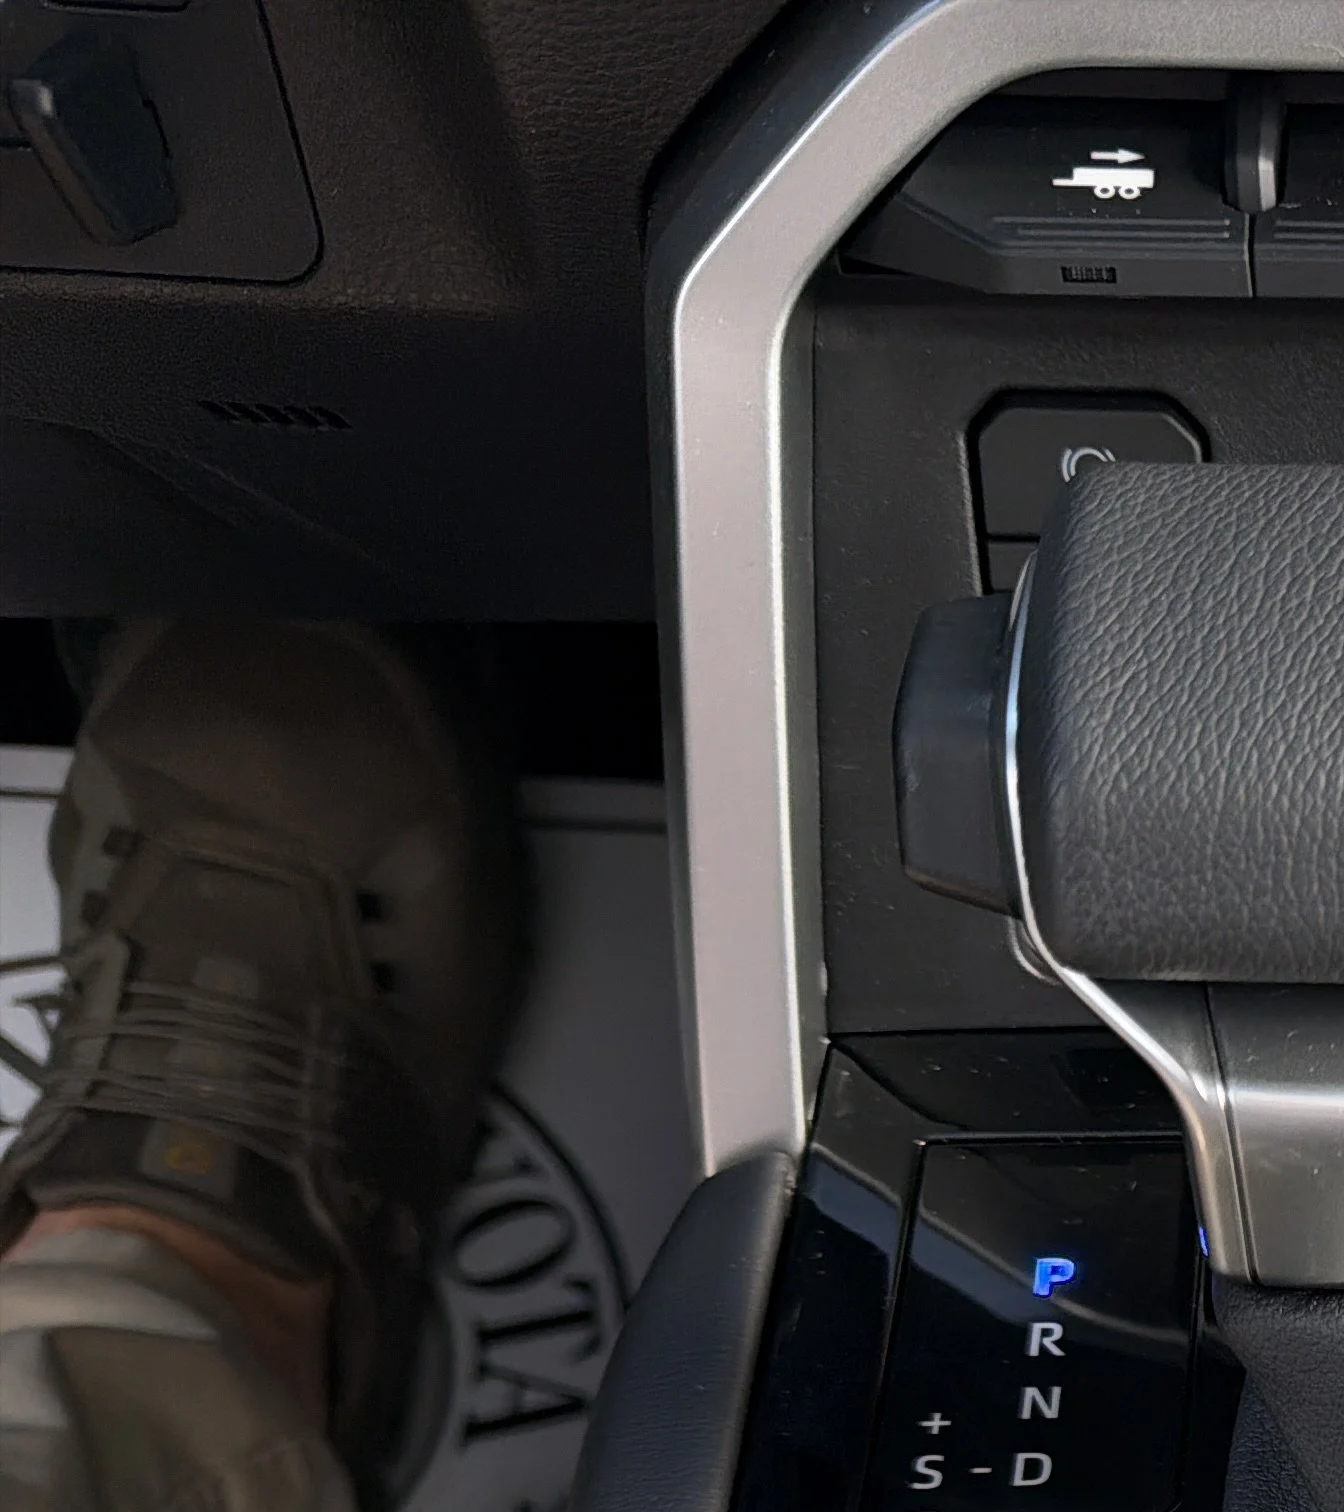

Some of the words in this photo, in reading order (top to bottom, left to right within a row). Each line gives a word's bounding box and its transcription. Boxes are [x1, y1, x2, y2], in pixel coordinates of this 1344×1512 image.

[1032, 1256, 1077, 1298] P
[1025, 1321, 1066, 1357] R
[1019, 1386, 1062, 1420] N
[906, 1453, 945, 1490] S
[1010, 1451, 1053, 1487] D
